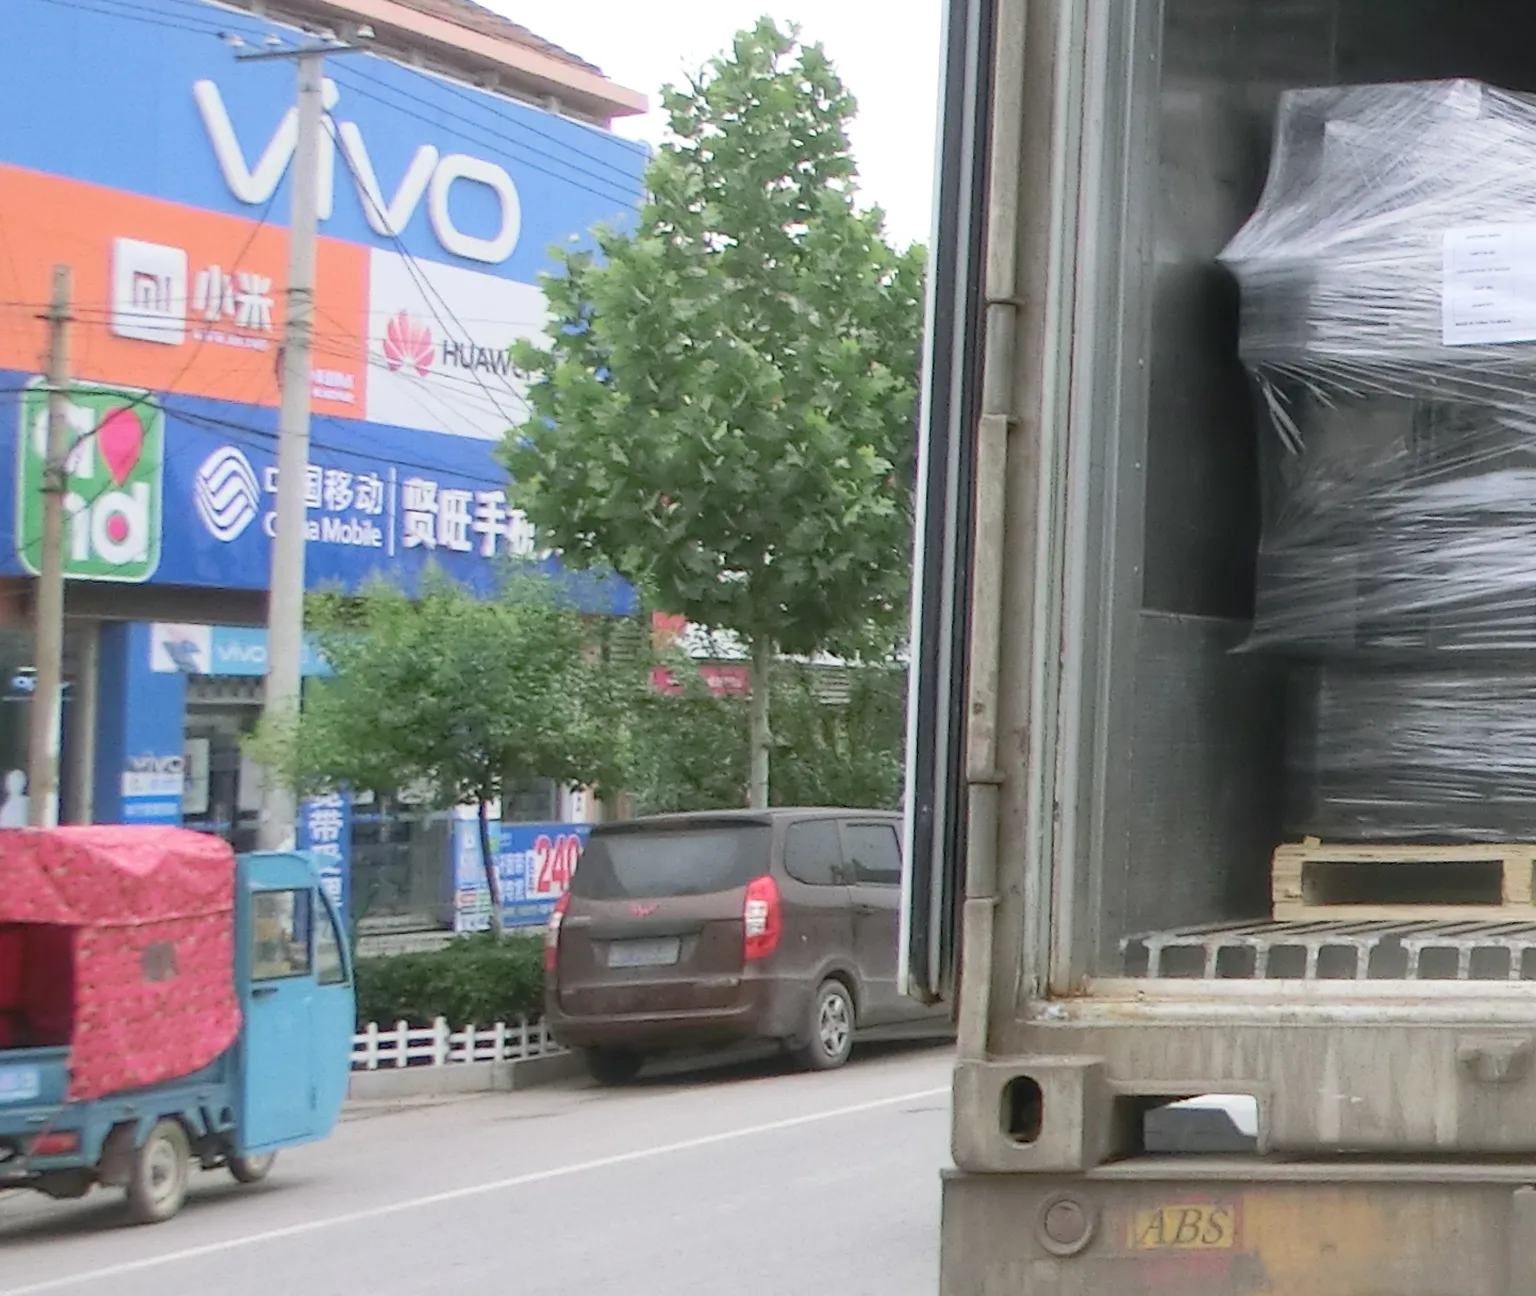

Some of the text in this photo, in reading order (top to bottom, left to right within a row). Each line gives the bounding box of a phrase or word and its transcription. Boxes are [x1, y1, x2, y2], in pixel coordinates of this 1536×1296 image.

[193, 264, 274, 333] 小米
[321, 517, 383, 548] Mobile
[218, 640, 268, 663] vivo
[1135, 1206, 1229, 1247] ABS
